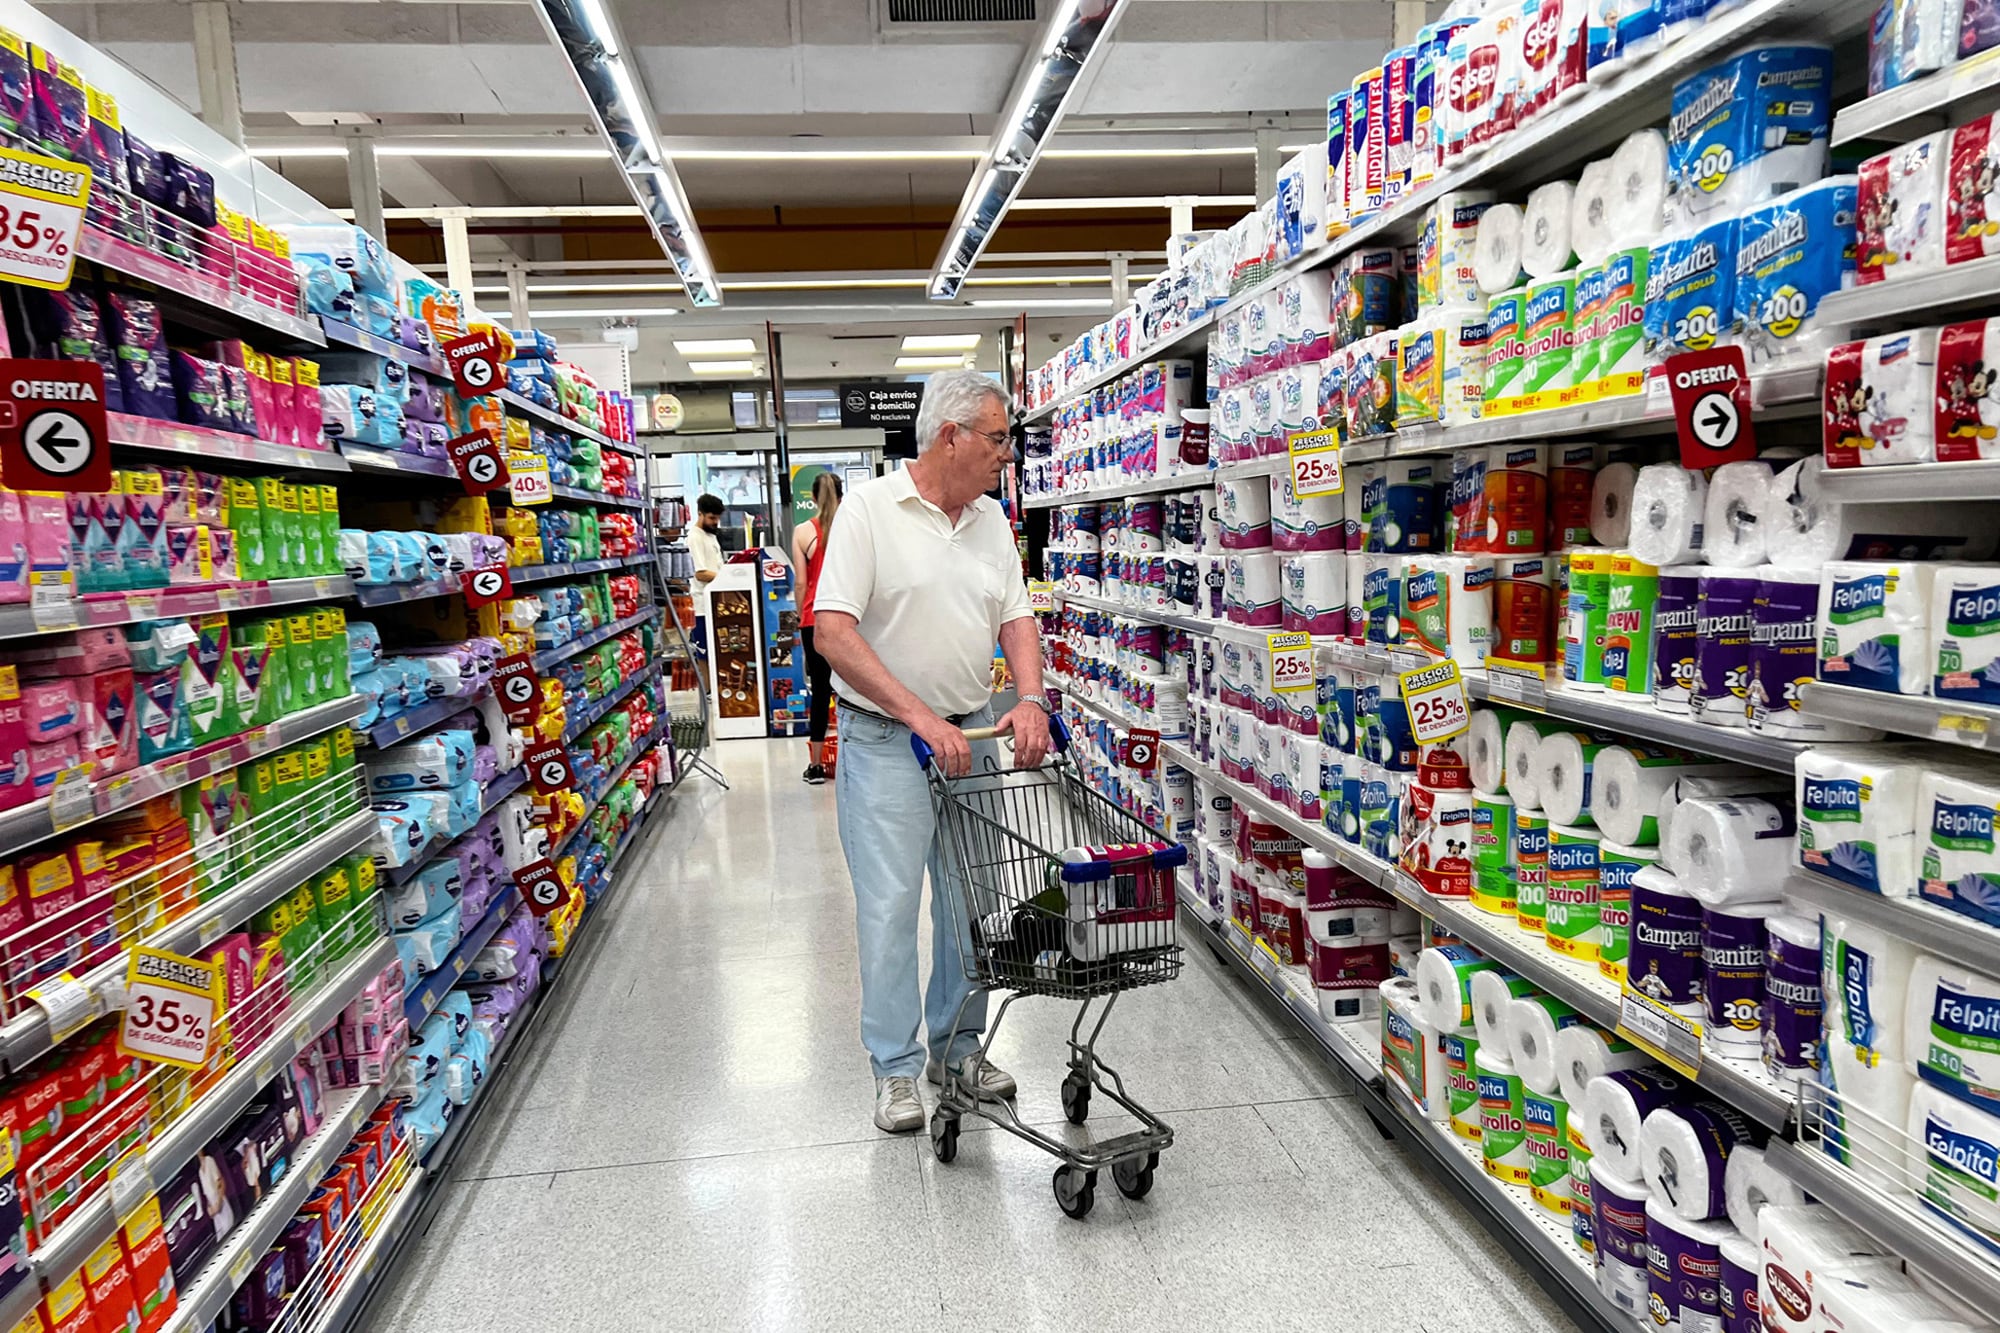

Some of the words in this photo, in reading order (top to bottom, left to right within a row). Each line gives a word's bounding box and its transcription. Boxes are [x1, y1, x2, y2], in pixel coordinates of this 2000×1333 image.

[1758, 65, 1823, 87] Campanita
[1367, 79, 1383, 188] INDIVIDUALES
[1692, 148, 1734, 182] 200
[1387, 181, 1400, 194] 70
[1367, 195, 1382, 207] 70
[1687, 274, 1716, 293] ROLLO
[1761, 292, 1807, 325] 200
[1674, 312, 1717, 341] 200
[1303, 332, 1313, 341] 50
[451, 341, 489, 359] OFERTA
[1675, 364, 1738, 389] OFERTA
[11, 379, 98, 402] OFERTA
[869, 391, 888, 400] Caja
[1462, 385, 1481, 397] 180
[877, 401, 916, 410] domicilio
[881, 413, 911, 421] exclusiva
[1304, 420, 1313, 429] 50
[455, 438, 492, 456] OFERTA
[1508, 451, 1534, 463] Felpita
[1296, 460, 1337, 481] 25%
[515, 476, 547, 493] 40%
[1307, 477, 1339, 488] DESCUENTO
[1305, 524, 1315, 533] 50
[1515, 561, 1541, 573] Felpita
[1031, 593, 1050, 605] 25%
[1833, 583, 1882, 608] Felpita
[1305, 608, 1315, 617] 50
[1468, 627, 1486, 638] 180
[1824, 639, 1836, 654] 70
[494, 660, 528, 677] OFERTA
[1275, 657, 1311, 676] 25%
[1671, 663, 1694, 678] 20
[1941, 654, 1960, 670] 70
[1303, 709, 1312, 717] 50
[1414, 696, 1463, 725] 25%
[1429, 714, 1467, 730] DESCUENTO
[1129, 733, 1156, 744] OFERTA
[530, 746, 562, 763] OFERTA
[1443, 770, 1457, 779] 120
[1172, 797, 1184, 806] 50
[1303, 793, 1311, 802] 50
[1806, 785, 1857, 808] Felpita
[1442, 811, 1468, 821] Felpita
[1935, 810, 1990, 836] Felpita
[1219, 829, 1232, 837] 50
[1518, 833, 1547, 852] Felp
[520, 864, 553, 884] OFERTA
[1440, 861, 1467, 872] Disney
[1925, 860, 1940, 877] 70
[1454, 878, 1468, 886] 120
[1846, 953, 1868, 1041] Felpita
[130, 995, 205, 1039] 35%
[1940, 998, 2000, 1032] Felpit
[143, 1032, 204, 1051] DESCUENTO
[1930, 1047, 1960, 1073] 140
[1479, 1080, 1505, 1097] pita
[1681, 1255, 1720, 1274] Campan
[1767, 1266, 1808, 1316] Sussex
